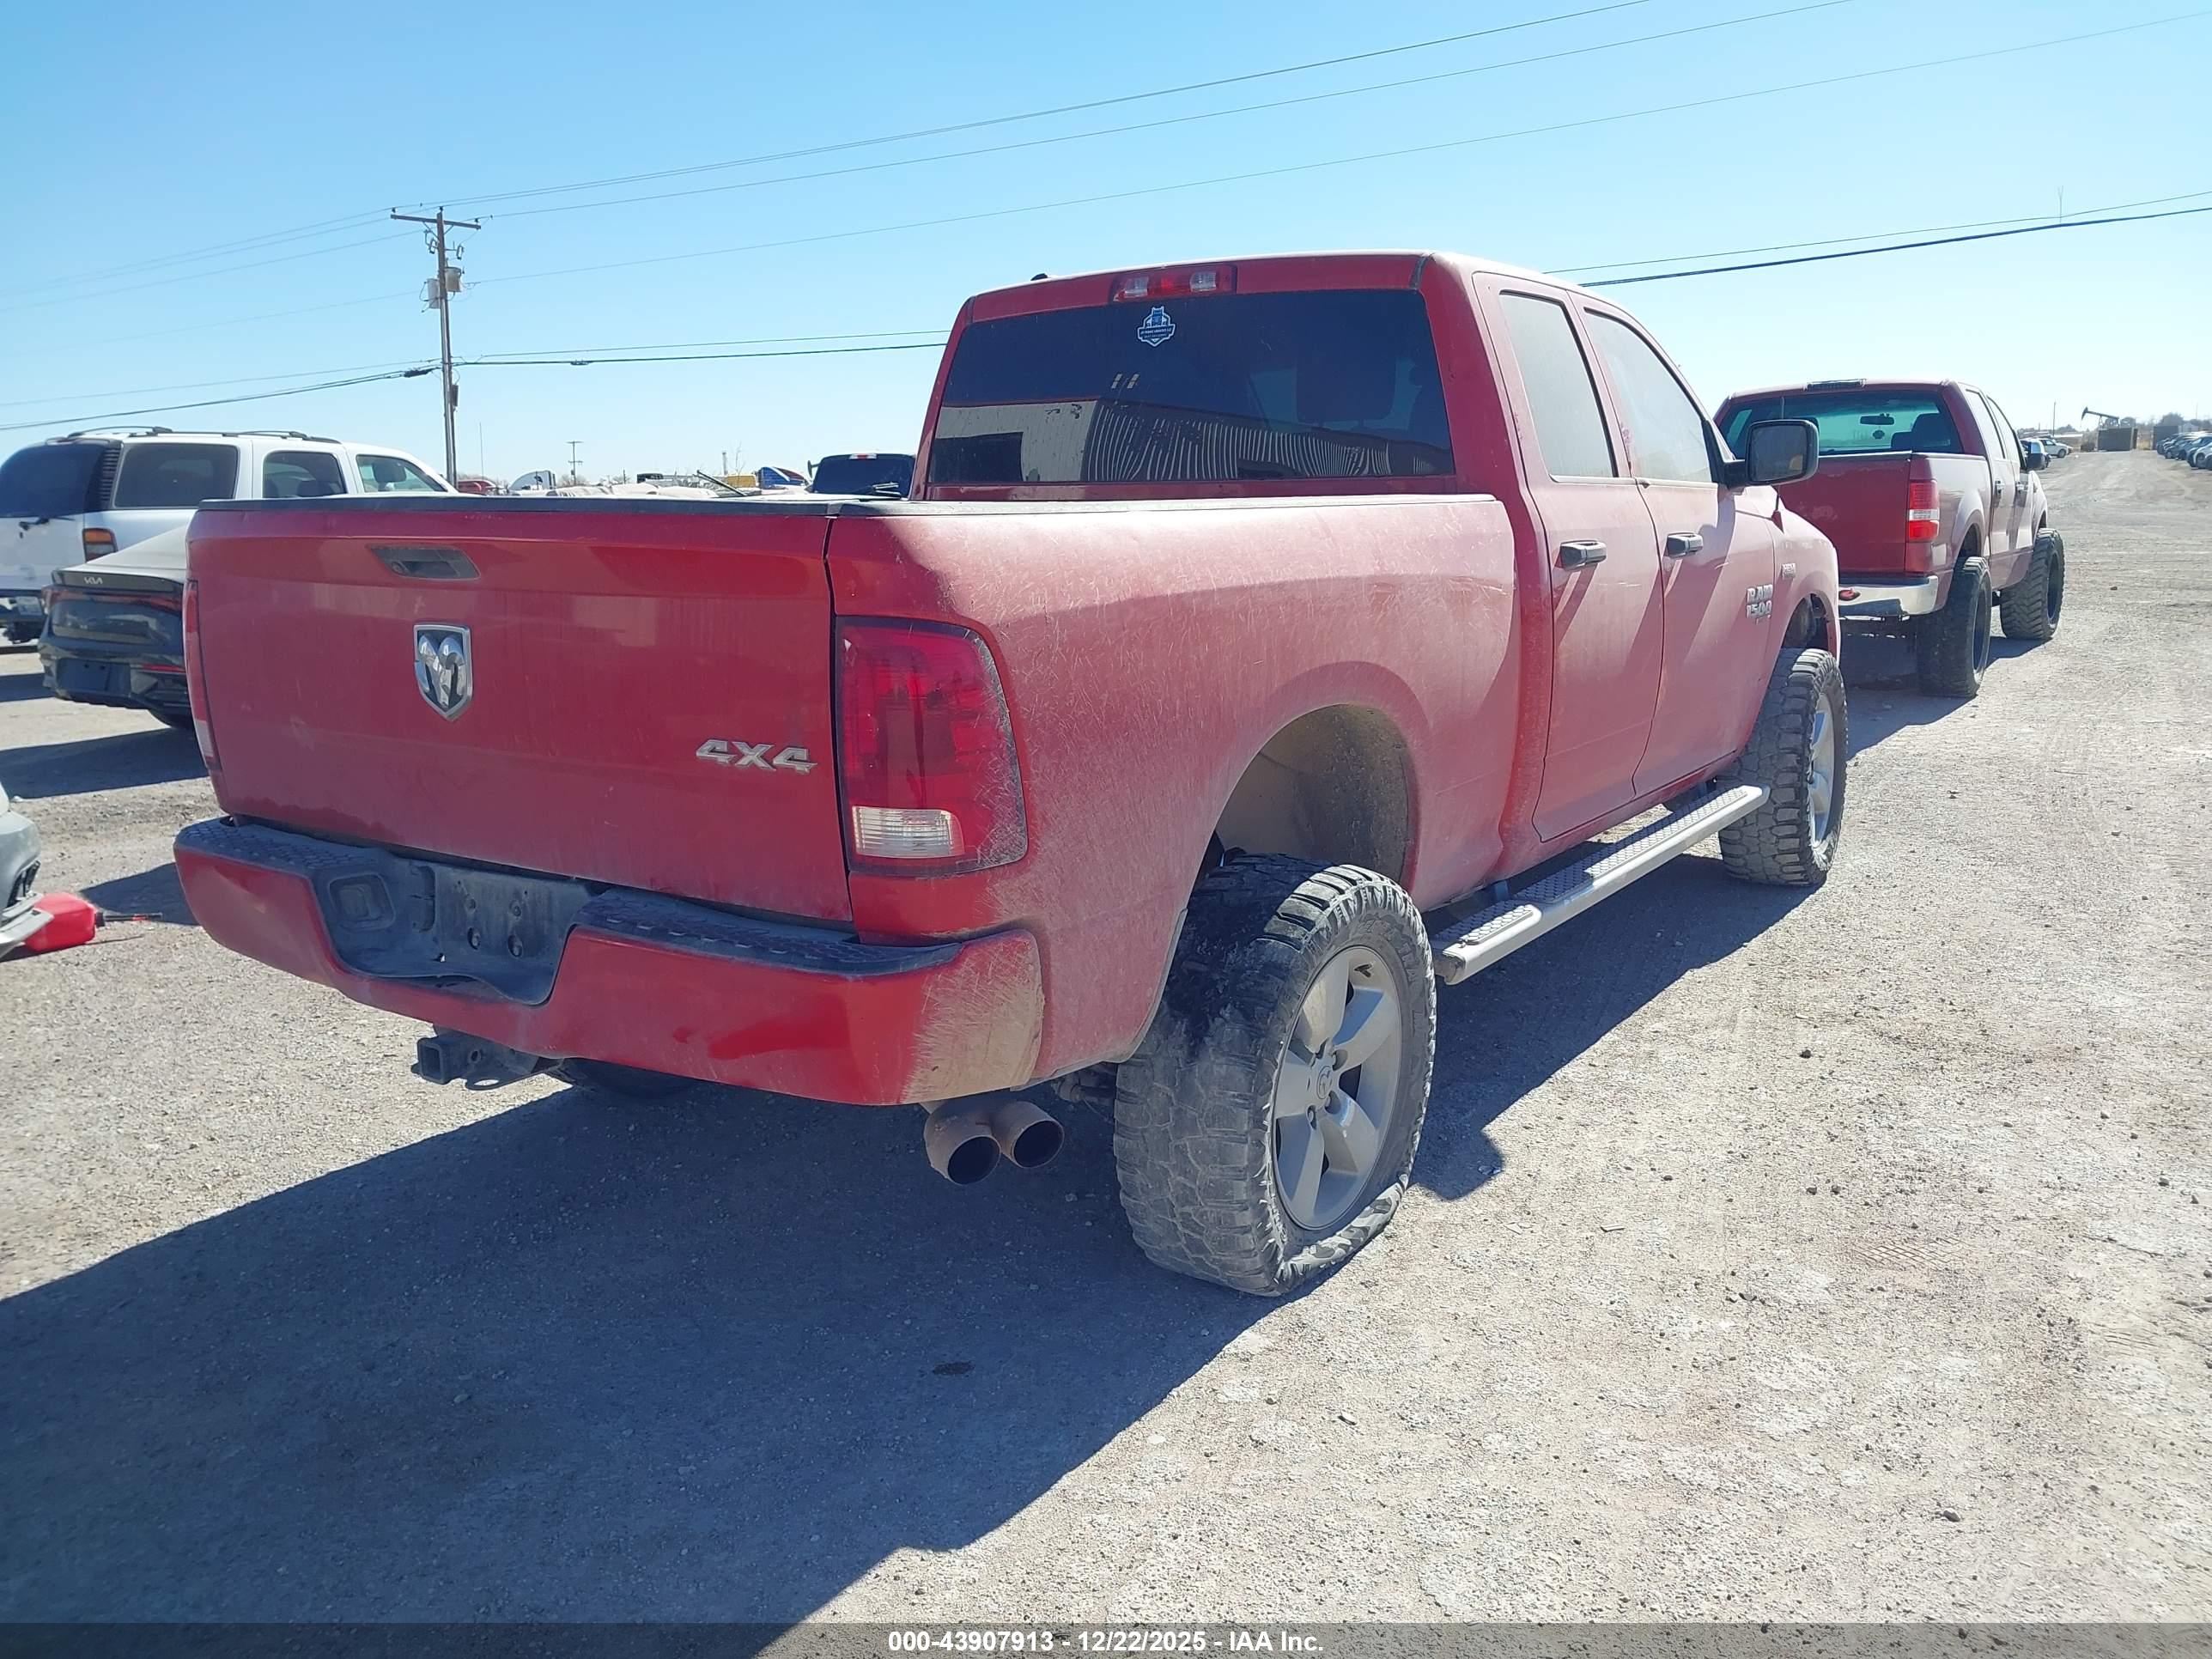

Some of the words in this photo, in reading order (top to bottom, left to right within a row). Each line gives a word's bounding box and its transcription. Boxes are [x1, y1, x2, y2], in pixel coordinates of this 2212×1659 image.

[83, 576, 103, 585] KIA
[1746, 584, 1773, 604] RAM
[1746, 600, 1772, 618] 1500
[696, 738, 817, 775] 4X4
